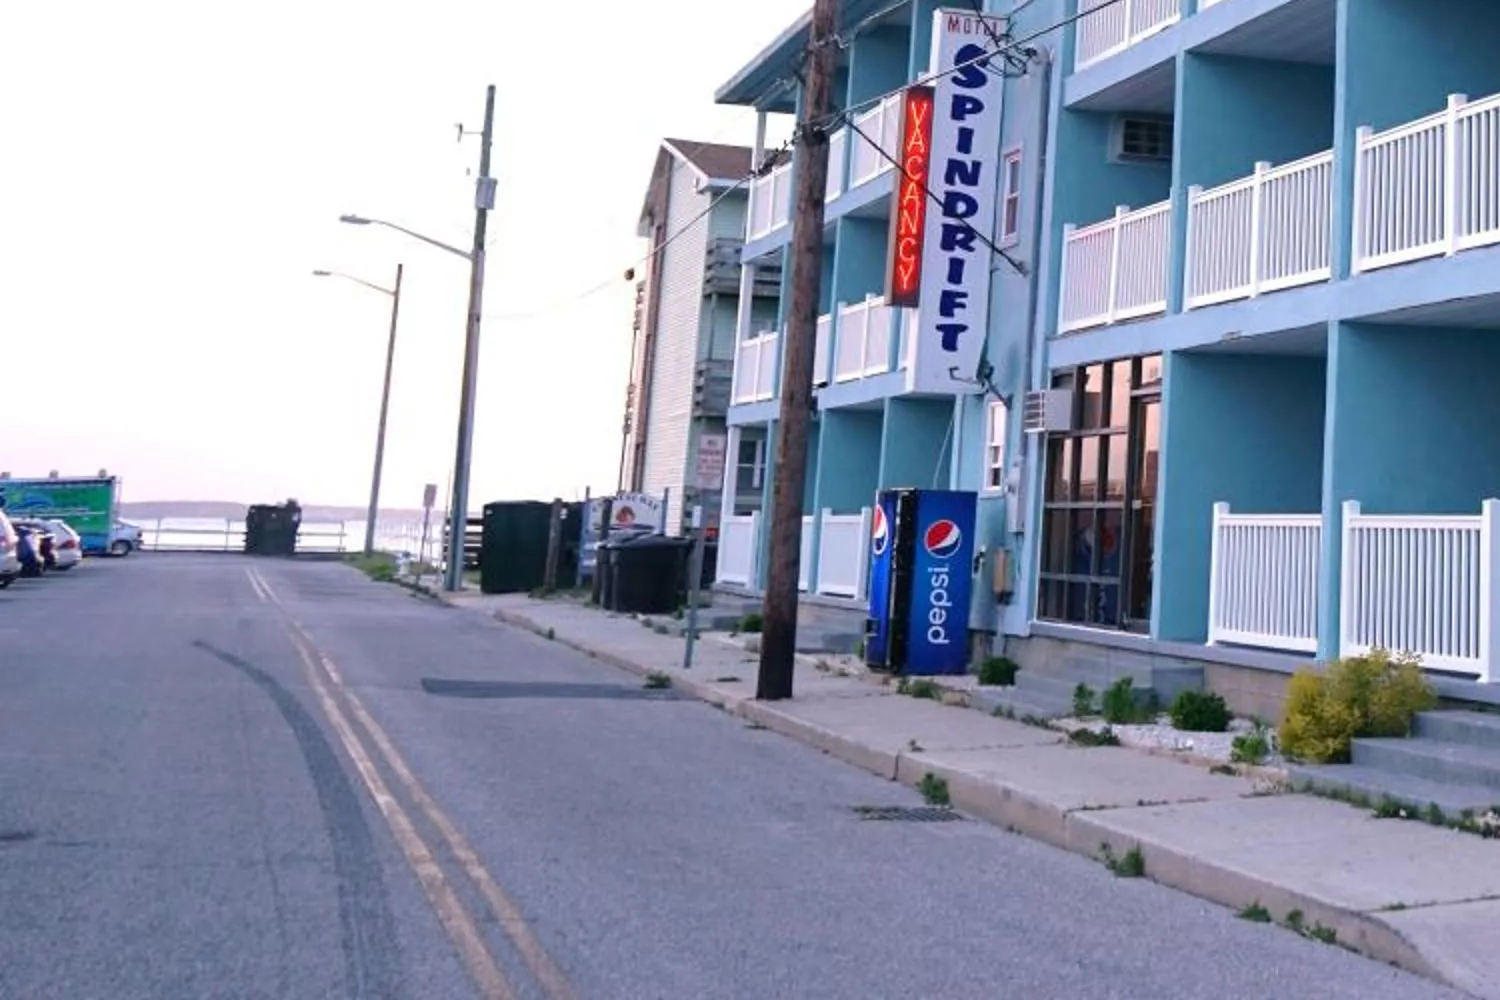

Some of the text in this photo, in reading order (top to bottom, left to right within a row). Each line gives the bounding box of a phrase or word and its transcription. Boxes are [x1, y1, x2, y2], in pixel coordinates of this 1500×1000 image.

[898, 101, 928, 291] VACANCY
[935, 43, 989, 352] SPINDRIFT
[928, 567, 952, 644] pepsi
